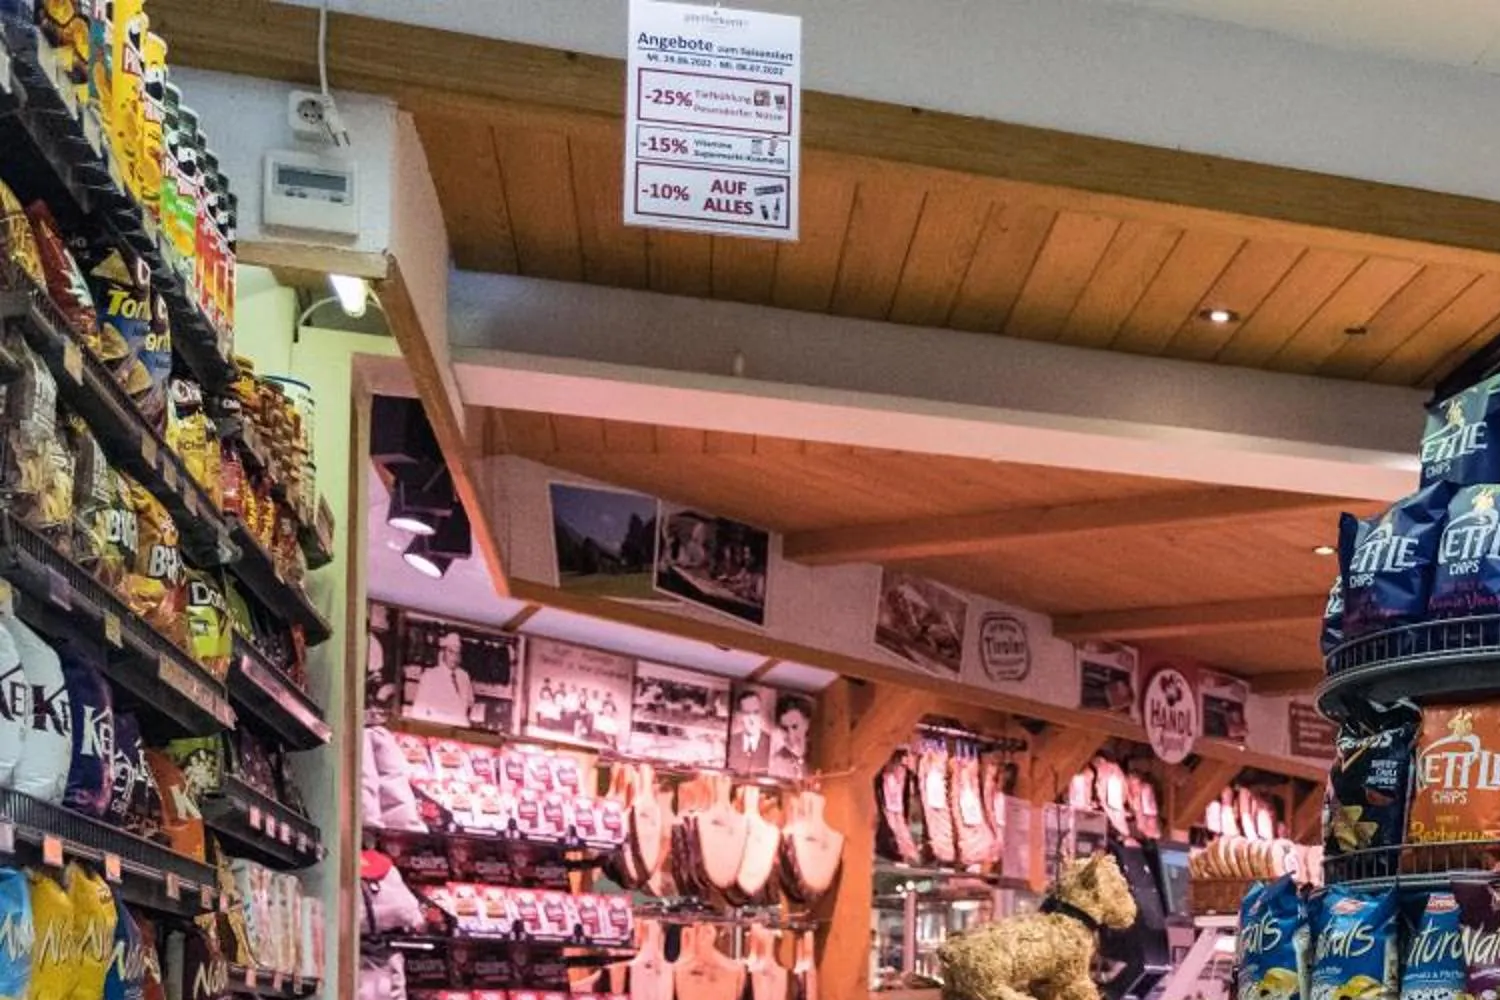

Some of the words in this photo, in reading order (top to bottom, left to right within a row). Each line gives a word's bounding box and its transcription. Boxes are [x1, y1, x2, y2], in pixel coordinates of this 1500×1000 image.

[637, 32, 713, 51] Angebote
[645, 89, 693, 107] -25%
[640, 136, 689, 154] -15%
[641, 183, 690, 201] -10%
[711, 179, 747, 196] AUF
[703, 197, 754, 215] ALLES
[1420, 421, 1488, 463] ETTLE
[1350, 523, 1420, 573] ETTLE
[1151, 699, 1193, 737] HANDL
